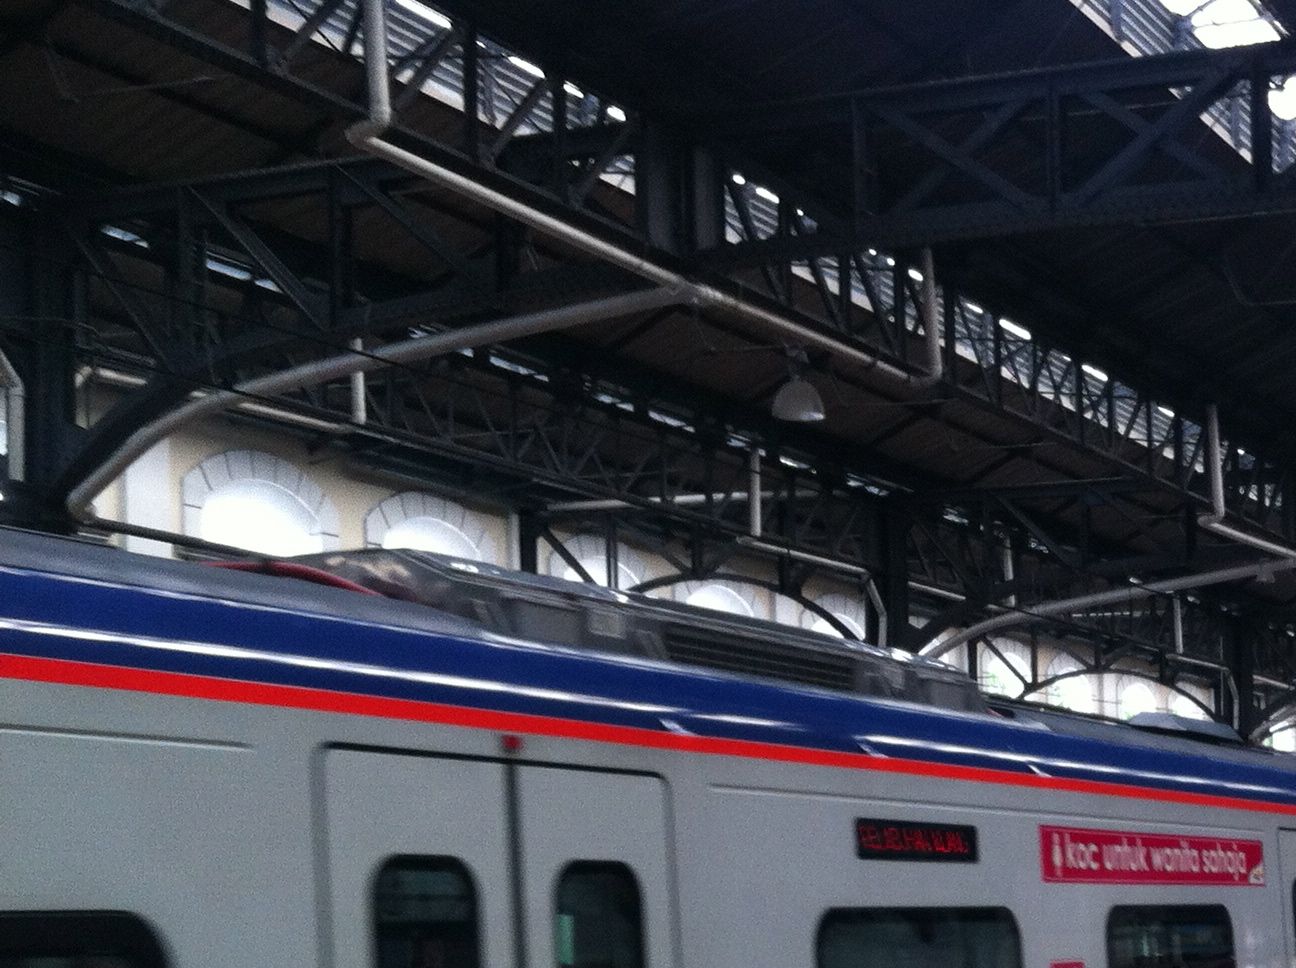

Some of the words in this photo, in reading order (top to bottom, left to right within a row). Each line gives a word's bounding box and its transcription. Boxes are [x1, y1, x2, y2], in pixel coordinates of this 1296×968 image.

[1102, 836, 1150, 873] untuk
[1151, 839, 1200, 875] wanita
[1202, 842, 1248, 883] sahaja
